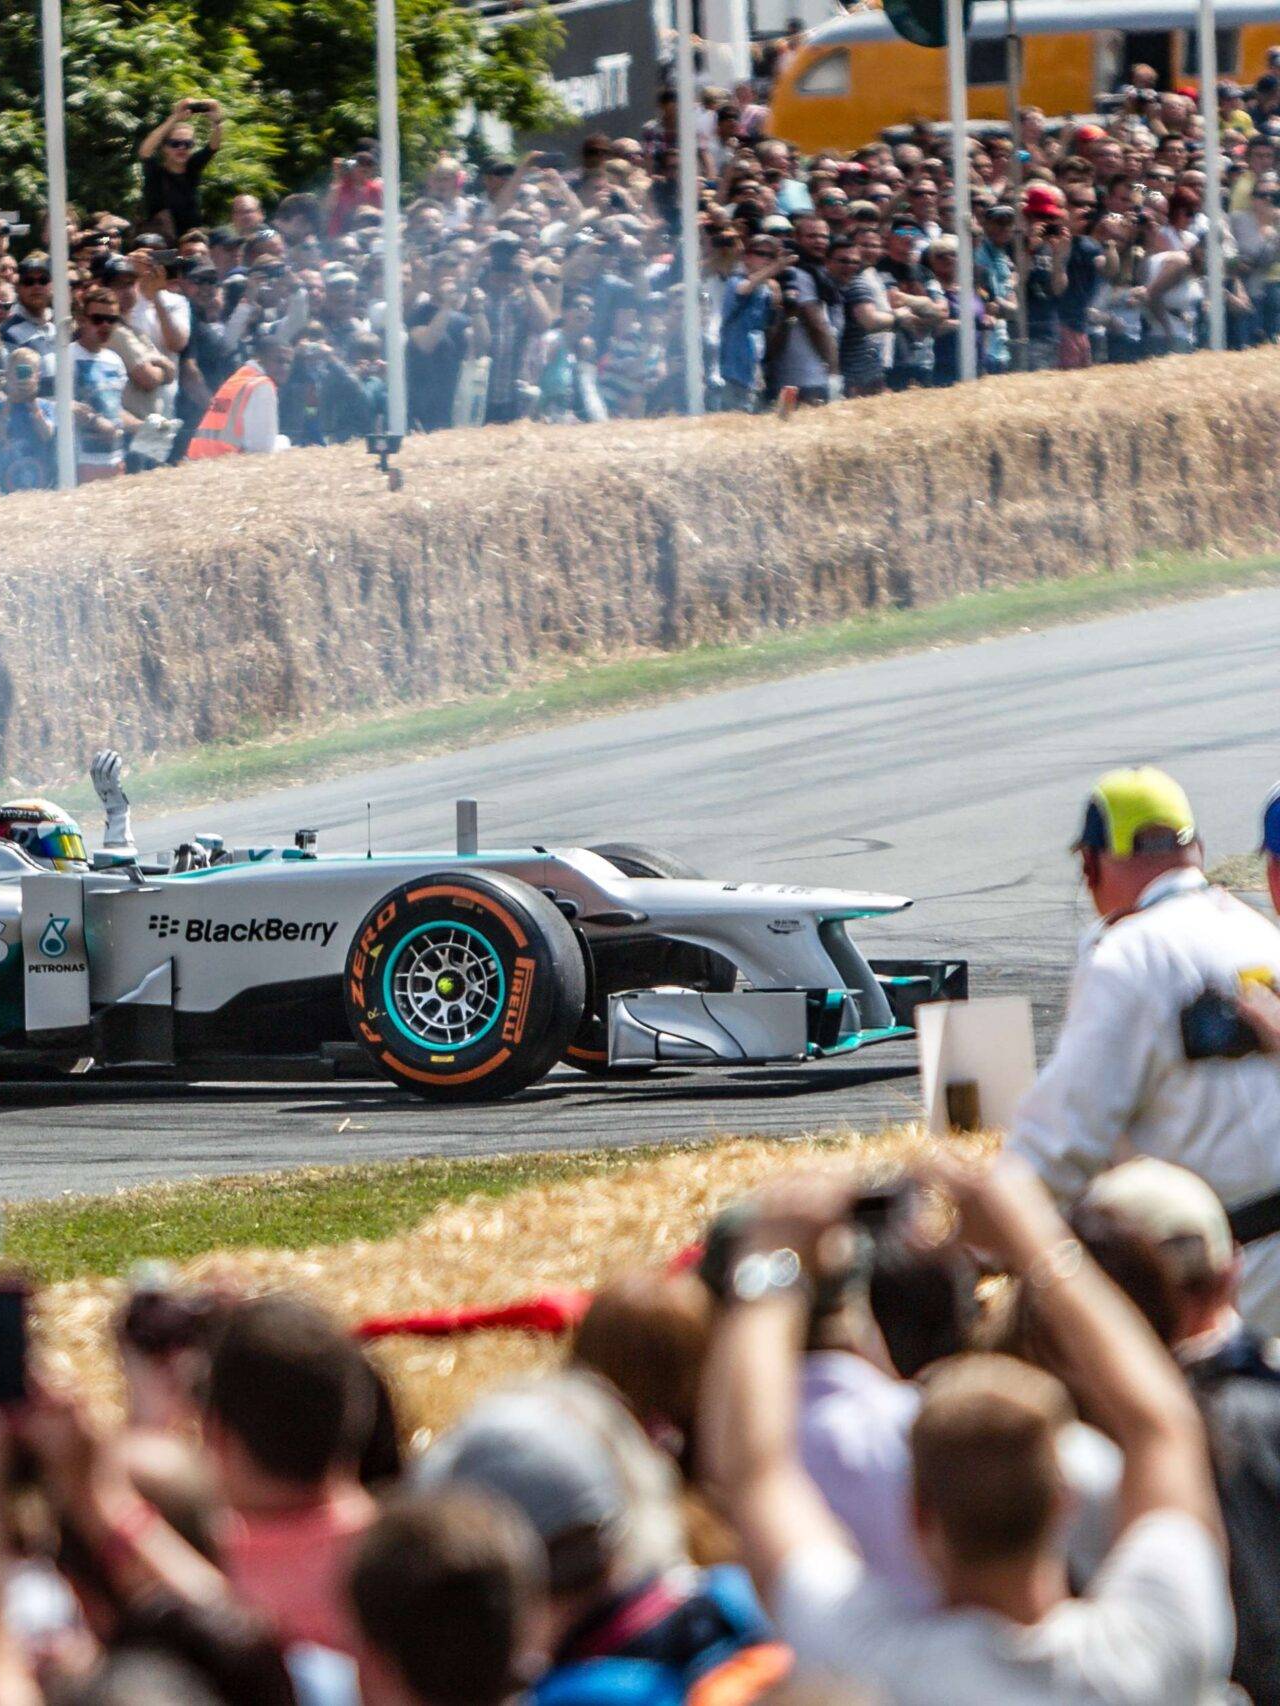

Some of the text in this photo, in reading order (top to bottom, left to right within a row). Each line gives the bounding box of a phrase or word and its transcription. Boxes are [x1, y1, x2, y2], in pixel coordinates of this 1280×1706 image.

[185, 918, 339, 947] BlackBerry
[350, 901, 397, 1008] ZERO
[27, 963, 88, 974] PETRONAS
[502, 956, 536, 1044] PIRELLI
